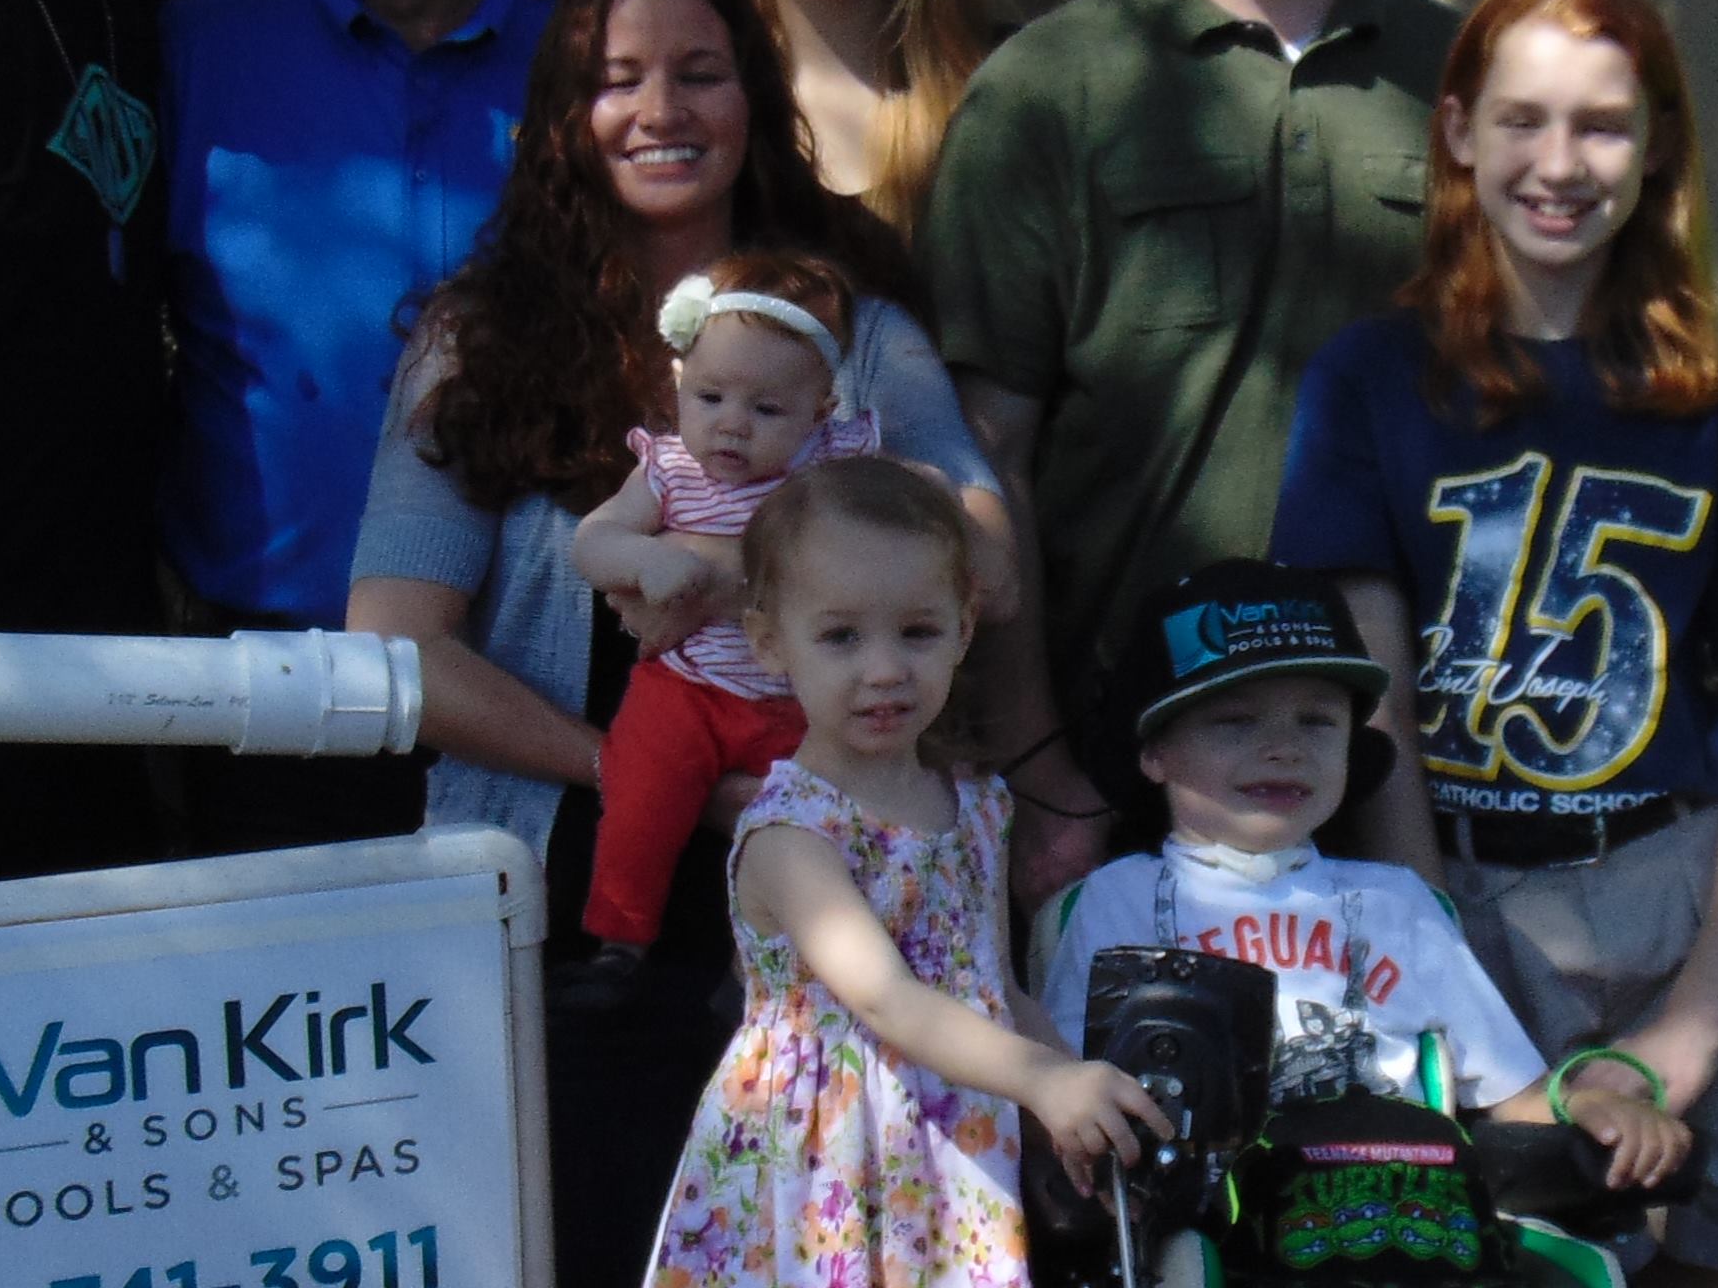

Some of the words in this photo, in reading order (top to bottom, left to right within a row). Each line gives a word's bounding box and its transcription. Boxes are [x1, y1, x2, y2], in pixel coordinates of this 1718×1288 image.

[1220, 602, 1279, 625] Van
[1269, 621, 1312, 634] SONS
[1421, 451, 1715, 792] 15
[1227, 634, 1283, 656] POOLS
[1487, 628, 1610, 714] Joseph
[82, 1122, 114, 1155] &
[142, 1095, 308, 1149] SONS
[207, 1163, 240, 1202] &
[277, 1138, 421, 1192] SPAS
